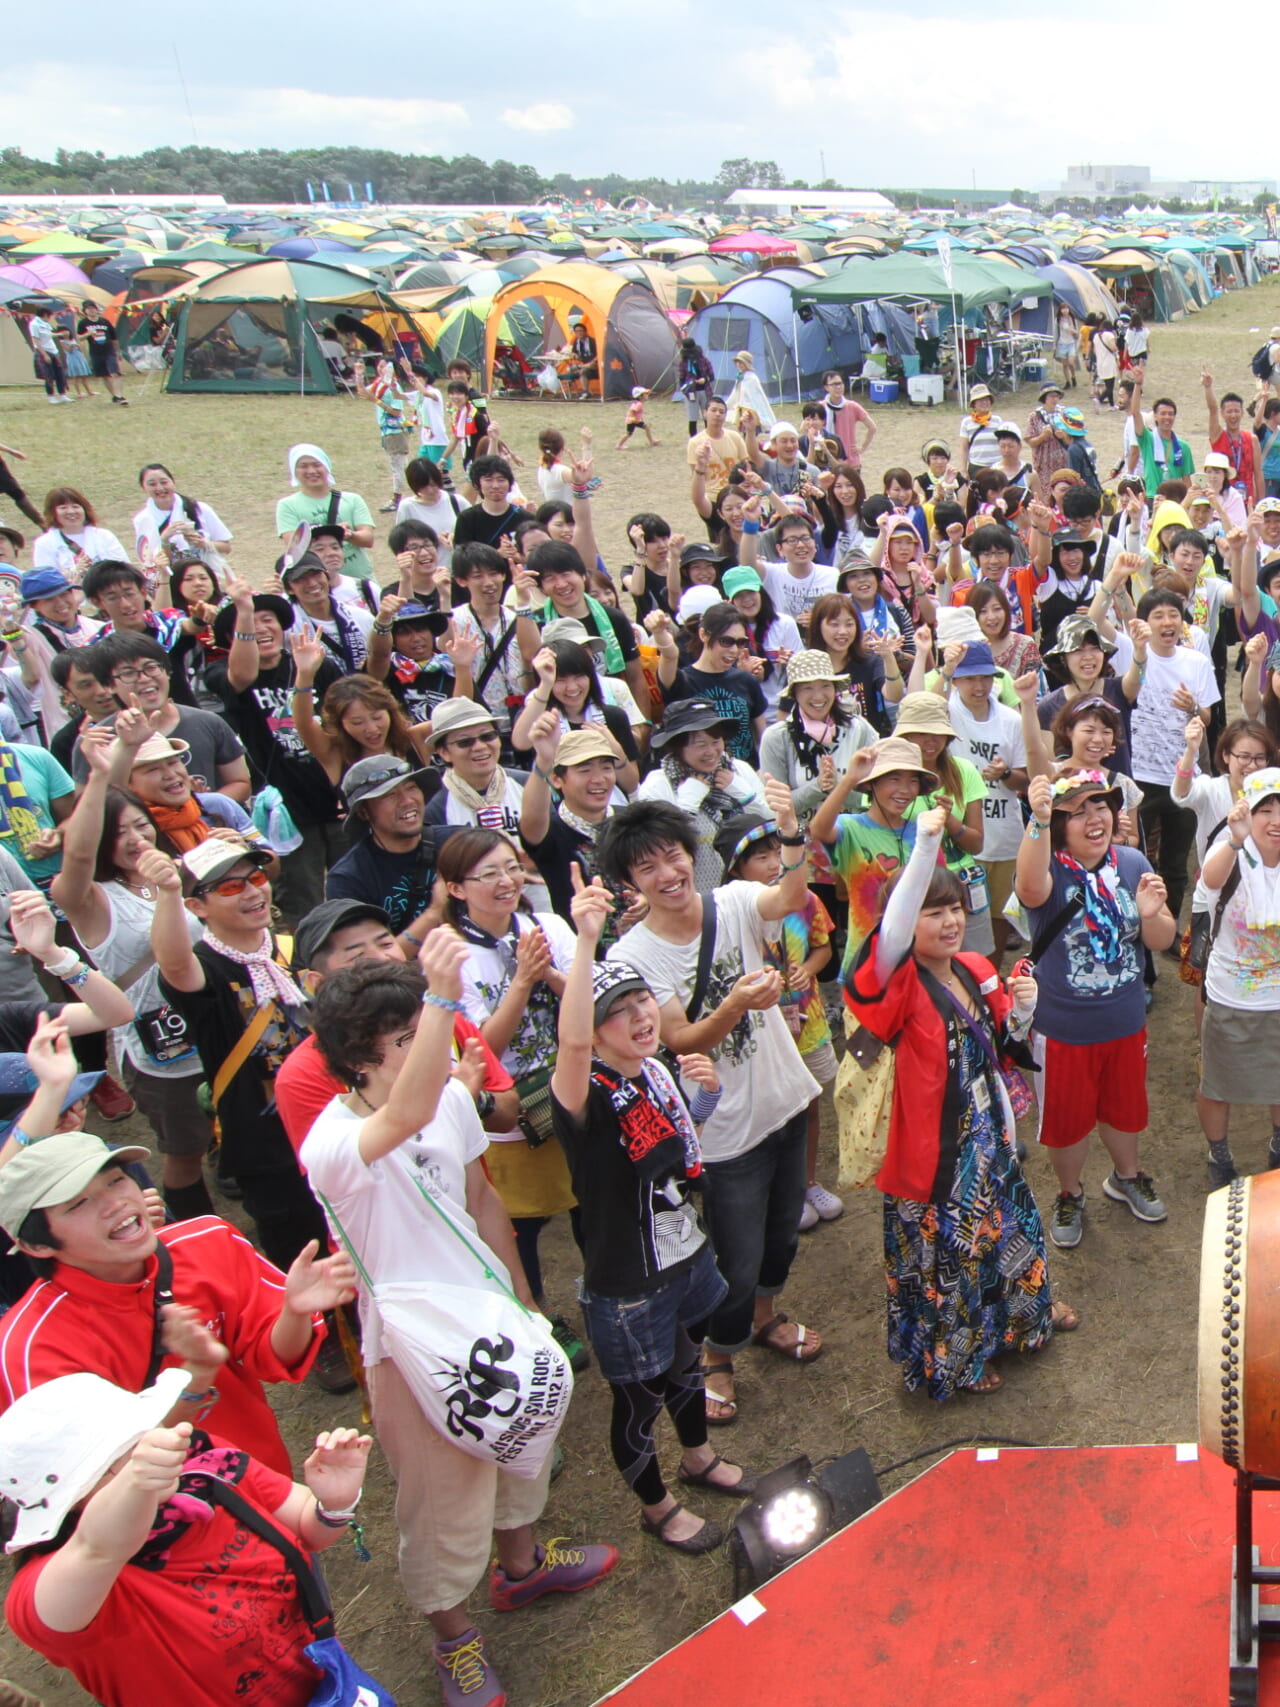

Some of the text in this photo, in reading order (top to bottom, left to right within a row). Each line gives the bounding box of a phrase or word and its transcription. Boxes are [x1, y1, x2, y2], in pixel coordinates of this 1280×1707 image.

[150, 1014, 187, 1042] 19
[489, 1416, 532, 1454] RISING
[495, 1420, 548, 1464] FESTIVAL
[542, 1381, 564, 1418] 2012
